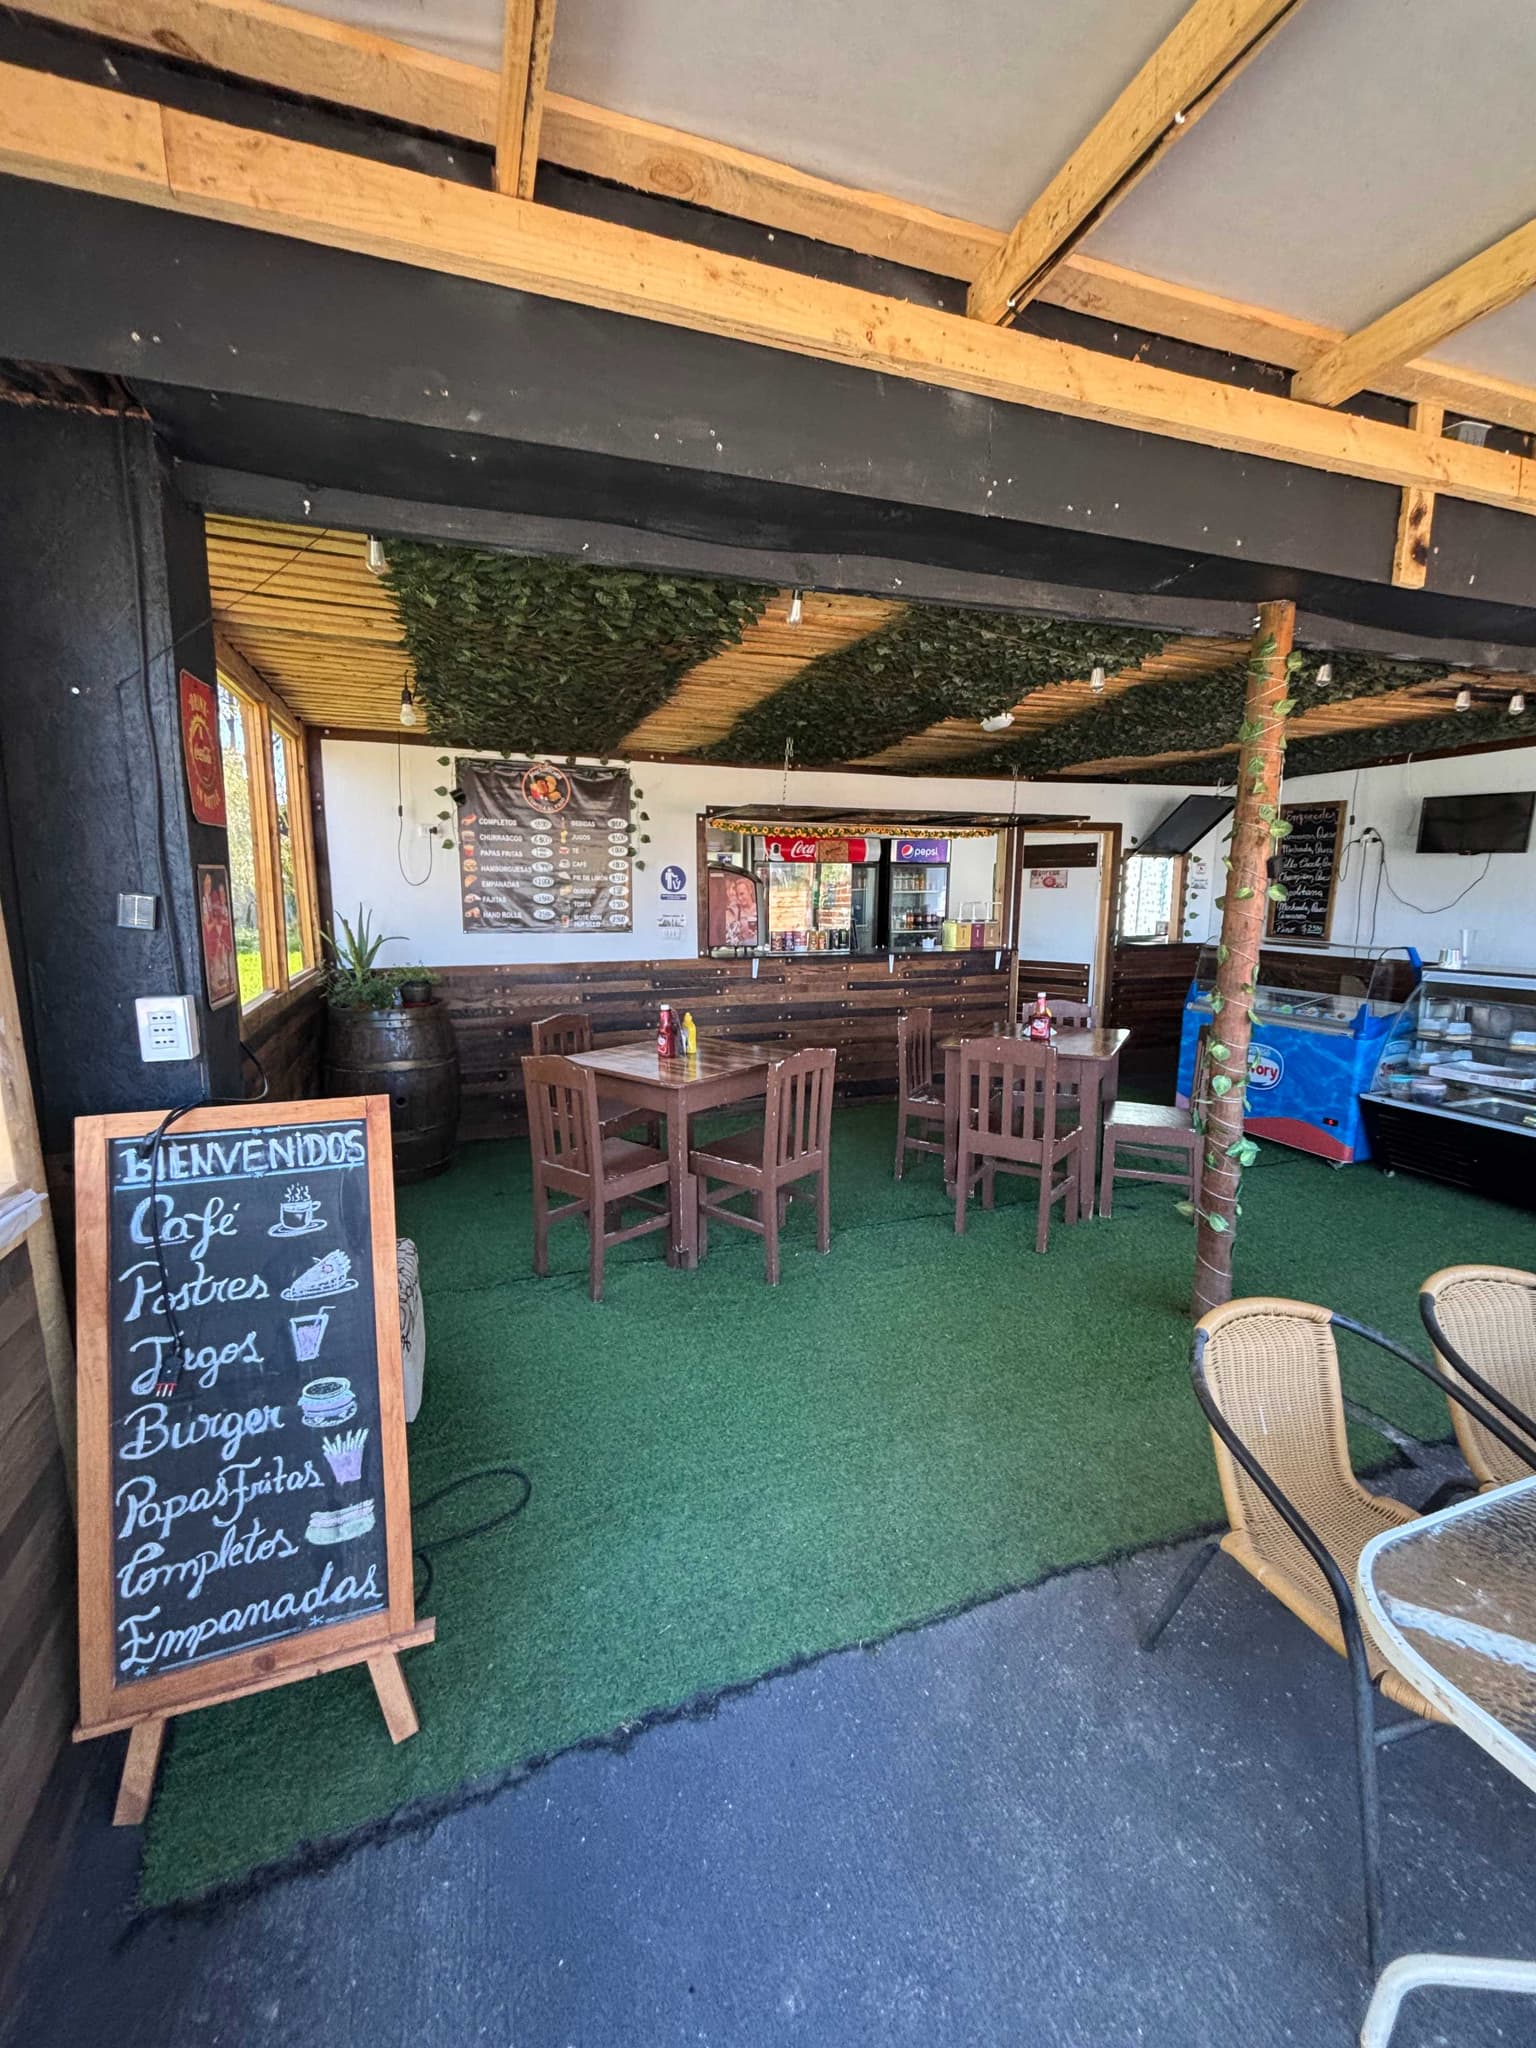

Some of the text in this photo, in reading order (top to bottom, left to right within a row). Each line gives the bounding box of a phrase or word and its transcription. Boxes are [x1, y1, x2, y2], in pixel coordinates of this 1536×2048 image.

[478, 818, 517, 826] COMPLETOS
[480, 834, 523, 842] CHURRASCOS
[480, 865, 533, 873] HAMBURGUESAS
[502, 850, 523, 858] FRITAS
[914, 847, 938, 857] pepsi
[481, 880, 520, 889] EMPANADAS
[130, 1194, 242, 1262] Café
[118, 1261, 270, 1322] Postres
[119, 1402, 286, 1461] Burger
[116, 1455, 326, 1541] Papas Fritas
[116, 1517, 299, 1600] Completos
[118, 1560, 384, 1672] Empanadas
